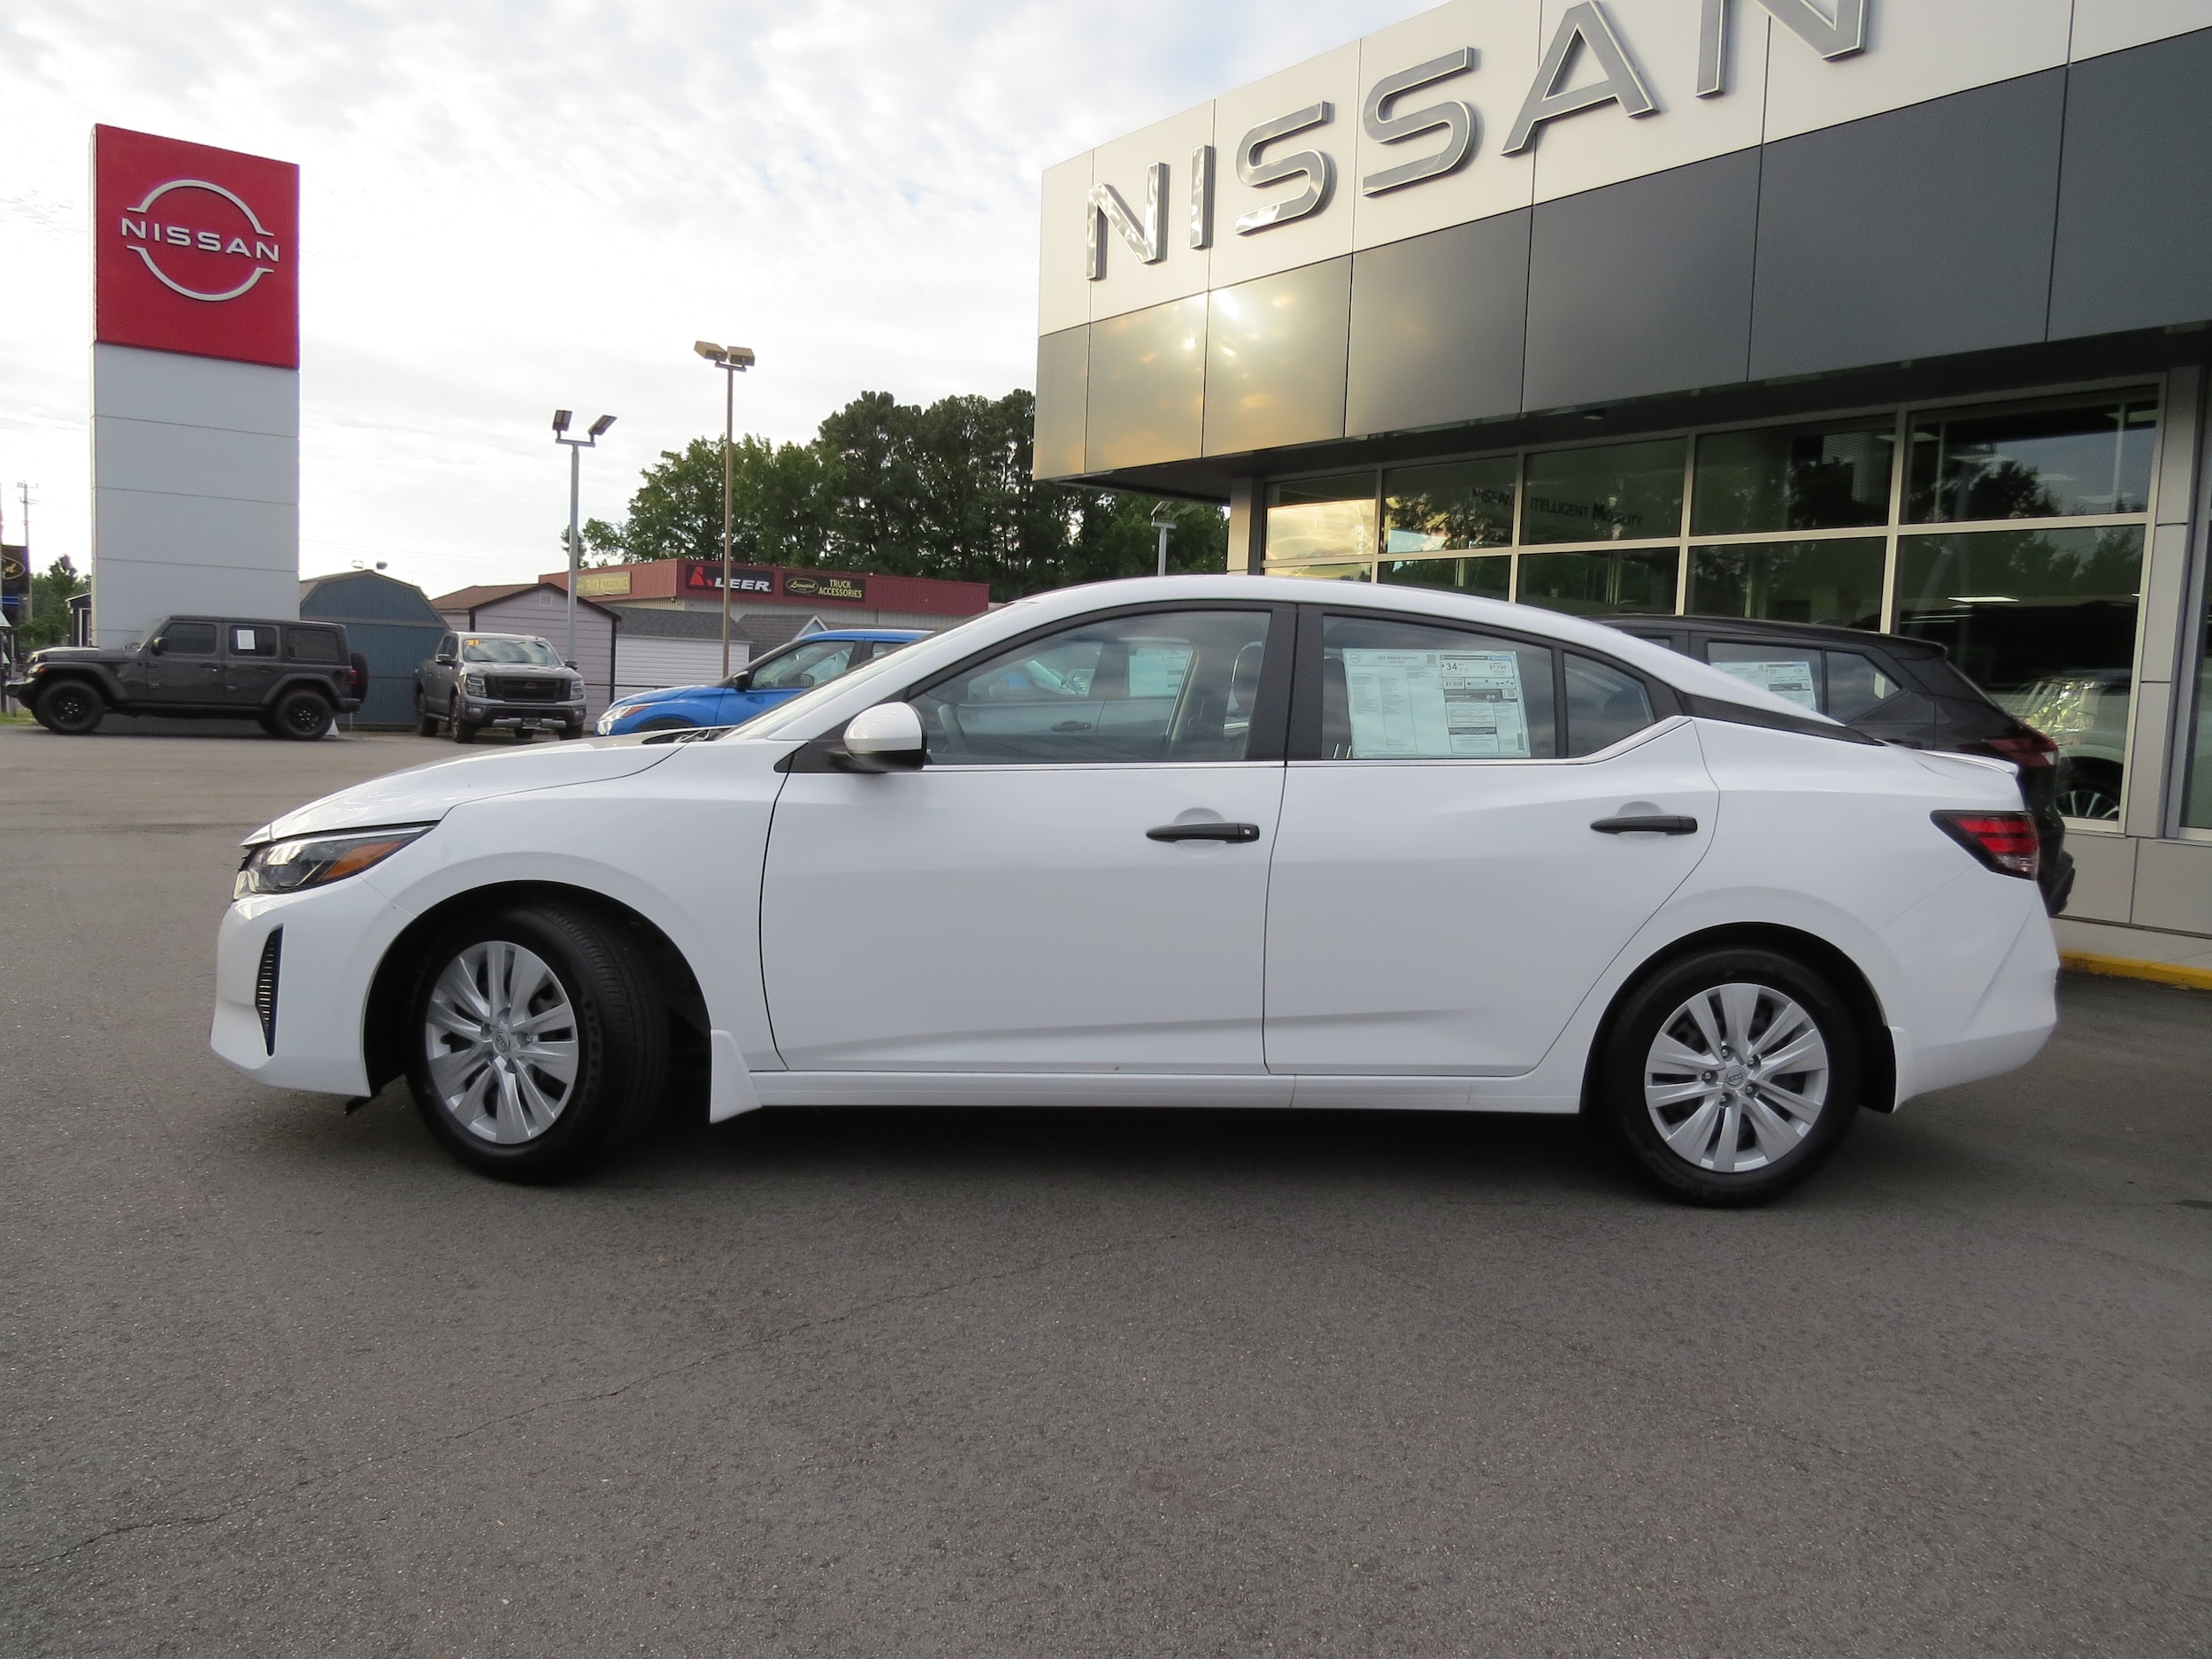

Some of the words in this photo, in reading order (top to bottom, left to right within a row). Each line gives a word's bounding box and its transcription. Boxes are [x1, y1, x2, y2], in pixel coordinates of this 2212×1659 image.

[121, 217, 280, 262] NISSAN
[714, 578, 770, 592] LEER
[829, 579, 852, 589] TRUCK
[818, 588, 863, 598] ACCESSORIES
